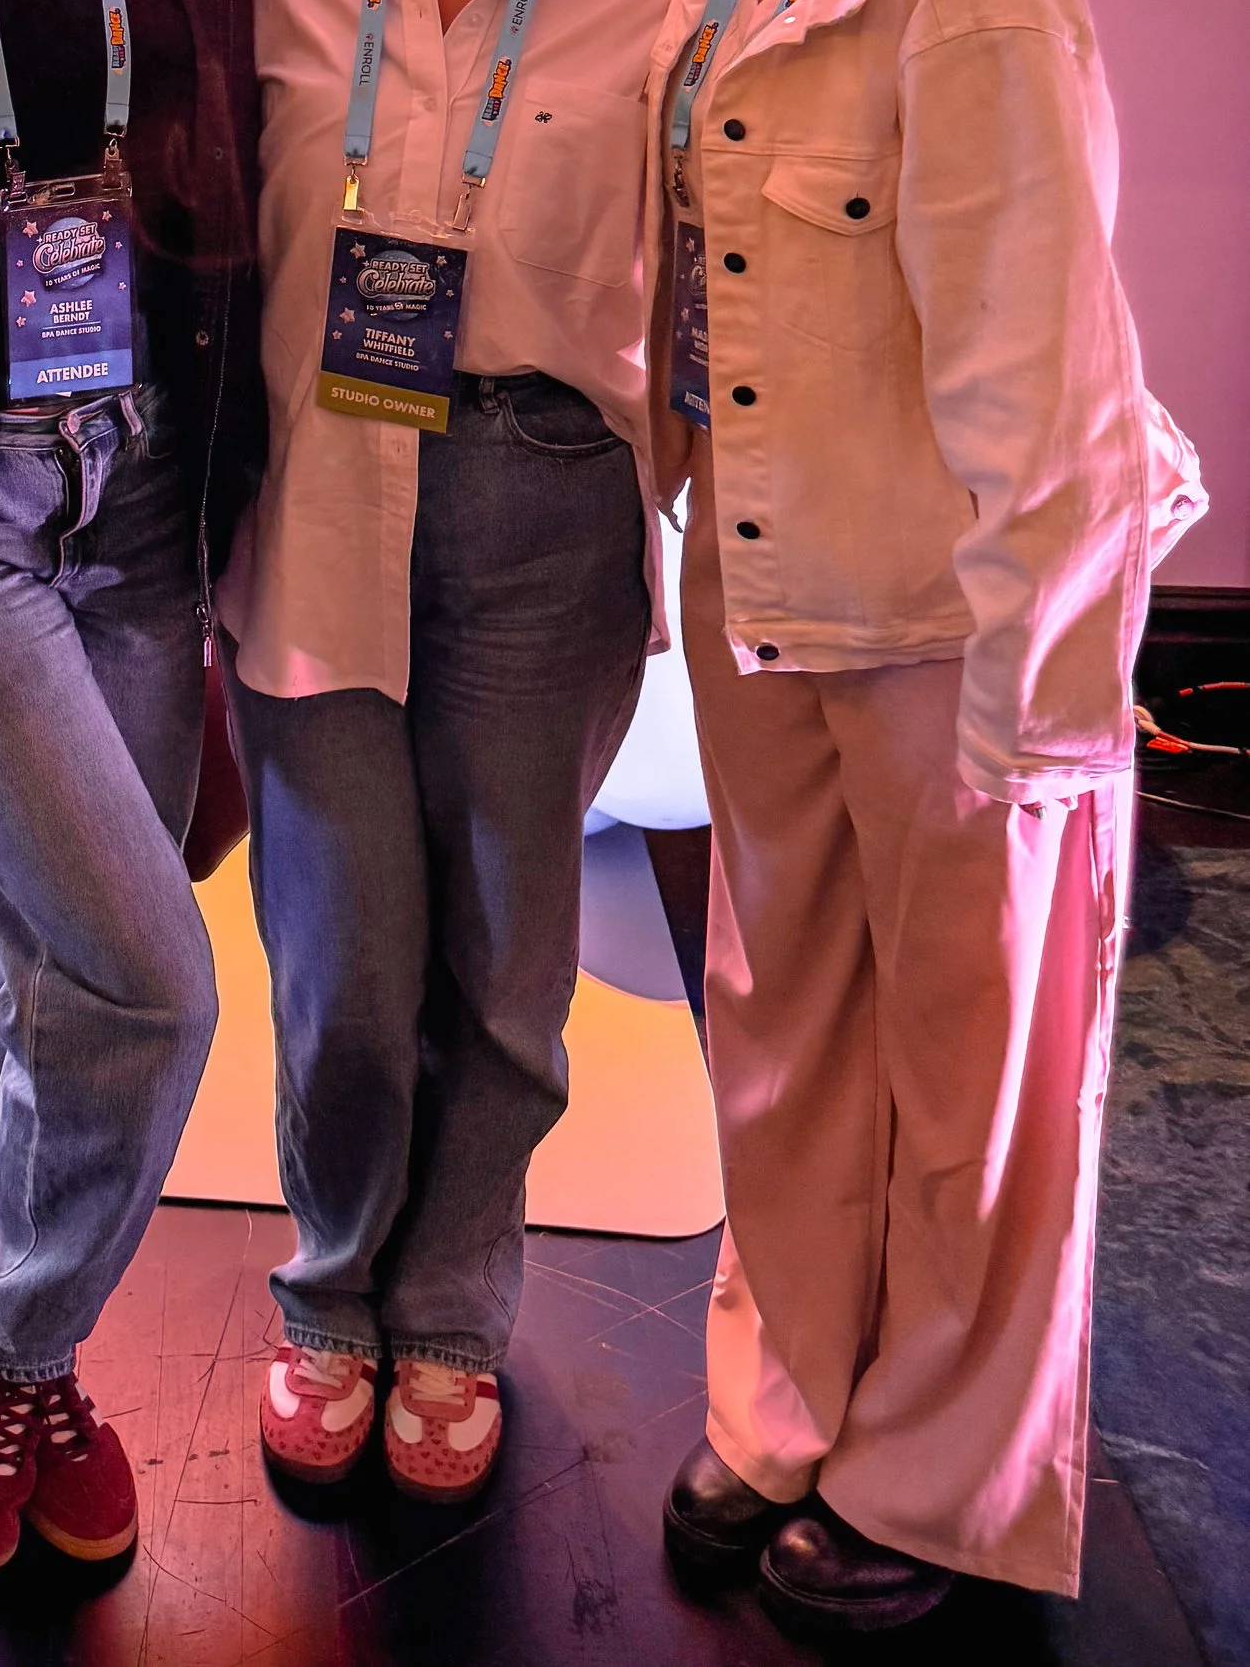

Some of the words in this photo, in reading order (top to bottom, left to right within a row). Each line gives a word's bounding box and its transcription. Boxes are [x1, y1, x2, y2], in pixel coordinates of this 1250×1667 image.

[358, 41, 375, 87] ENROLL
[45, 228, 77, 243] READY
[79, 225, 96, 236] SET
[34, 236, 105, 272] Celebrate
[371, 260, 408, 271] READY
[409, 263, 428, 273] SET
[54, 274, 72, 285] YEARS
[358, 269, 434, 297] Celebrate
[50, 299, 93, 314] ASHLEE
[53, 312, 90, 324] BERNDT
[56, 329, 77, 337] DANCE
[78, 325, 101, 334] STUDIO
[365, 327, 416, 347] TIFFANY
[363, 338, 415, 357] WHITFIELD
[370, 355, 393, 366] DANCE
[394, 361, 419, 371] STUDIO
[37, 363, 108, 384] ATTENDEE
[331, 387, 380, 407] STUDIO
[382, 397, 436, 419] OWNER
